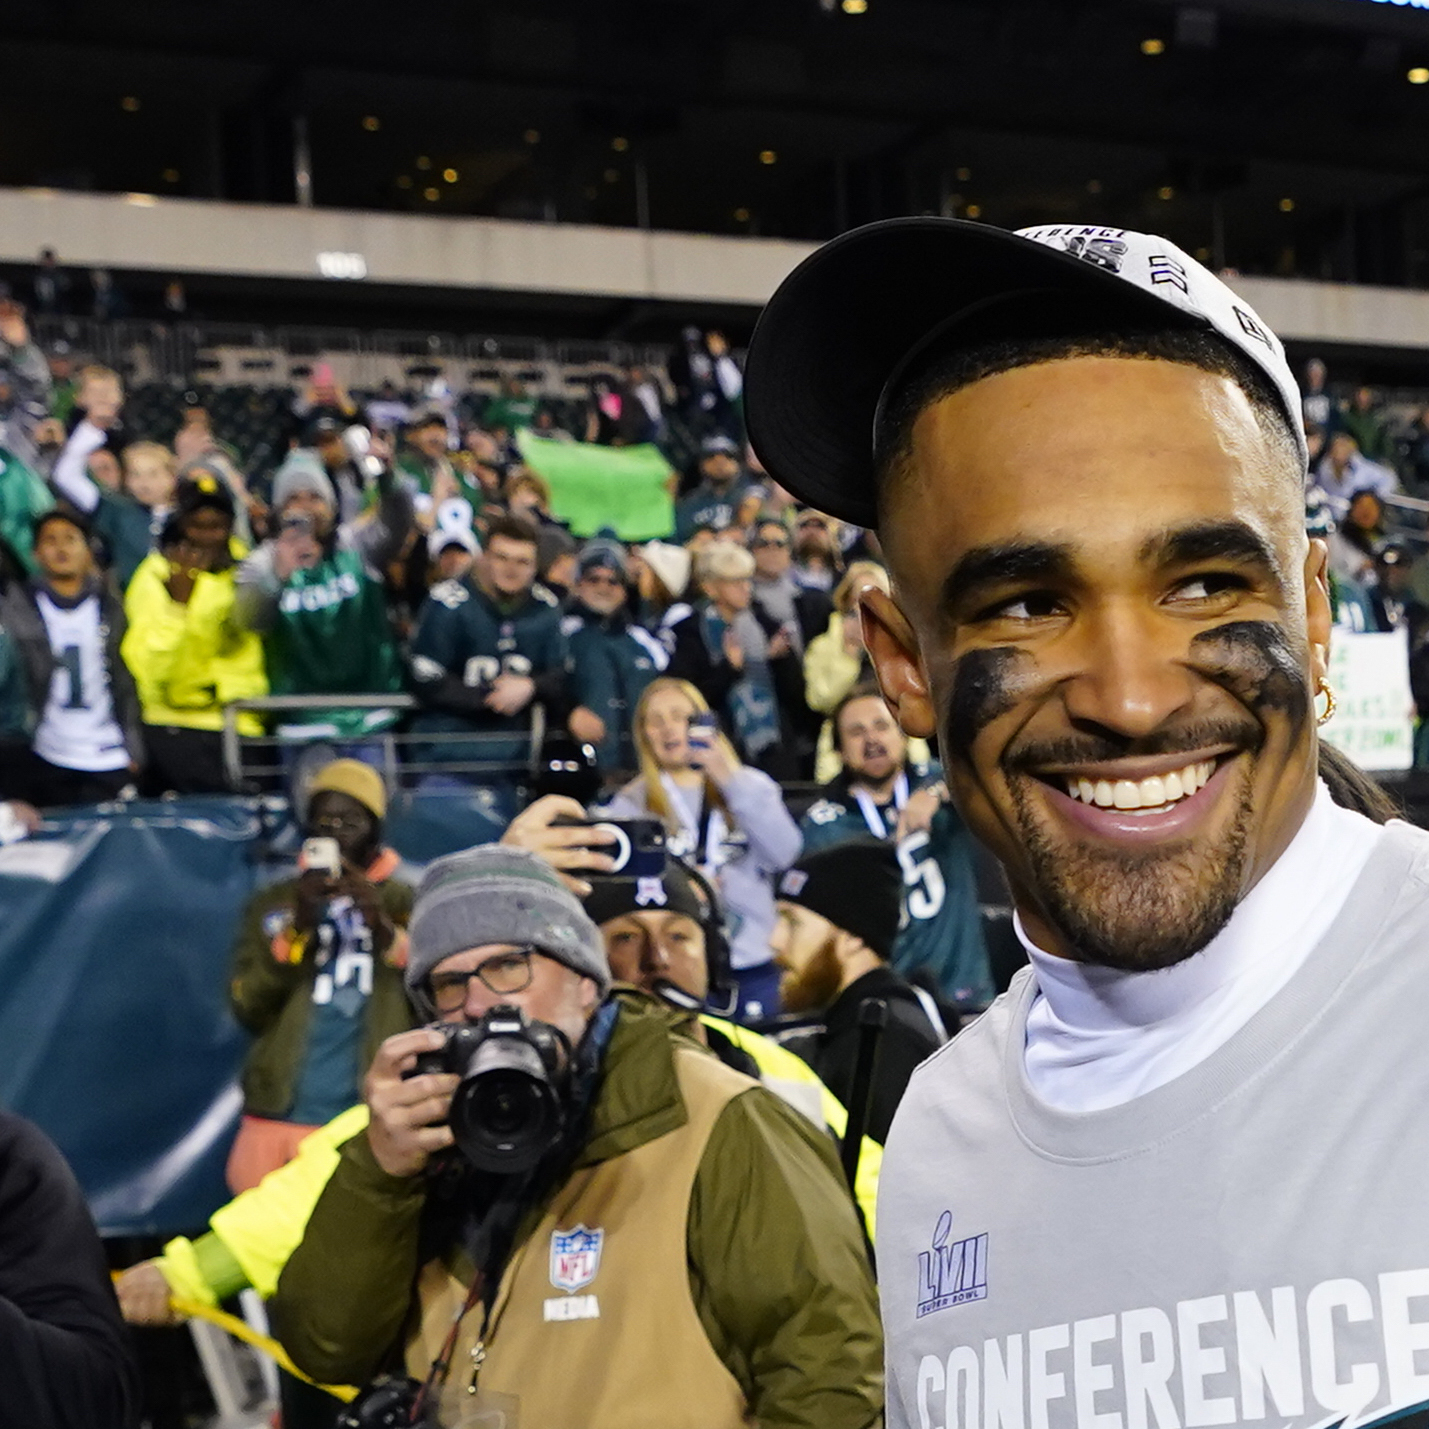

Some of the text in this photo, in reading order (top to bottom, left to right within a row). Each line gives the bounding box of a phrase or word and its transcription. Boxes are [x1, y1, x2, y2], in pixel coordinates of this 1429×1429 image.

[57, 645, 89, 710] 1
[896, 830, 946, 920] 5
[921, 1290, 979, 1314] SUPER BOWL
